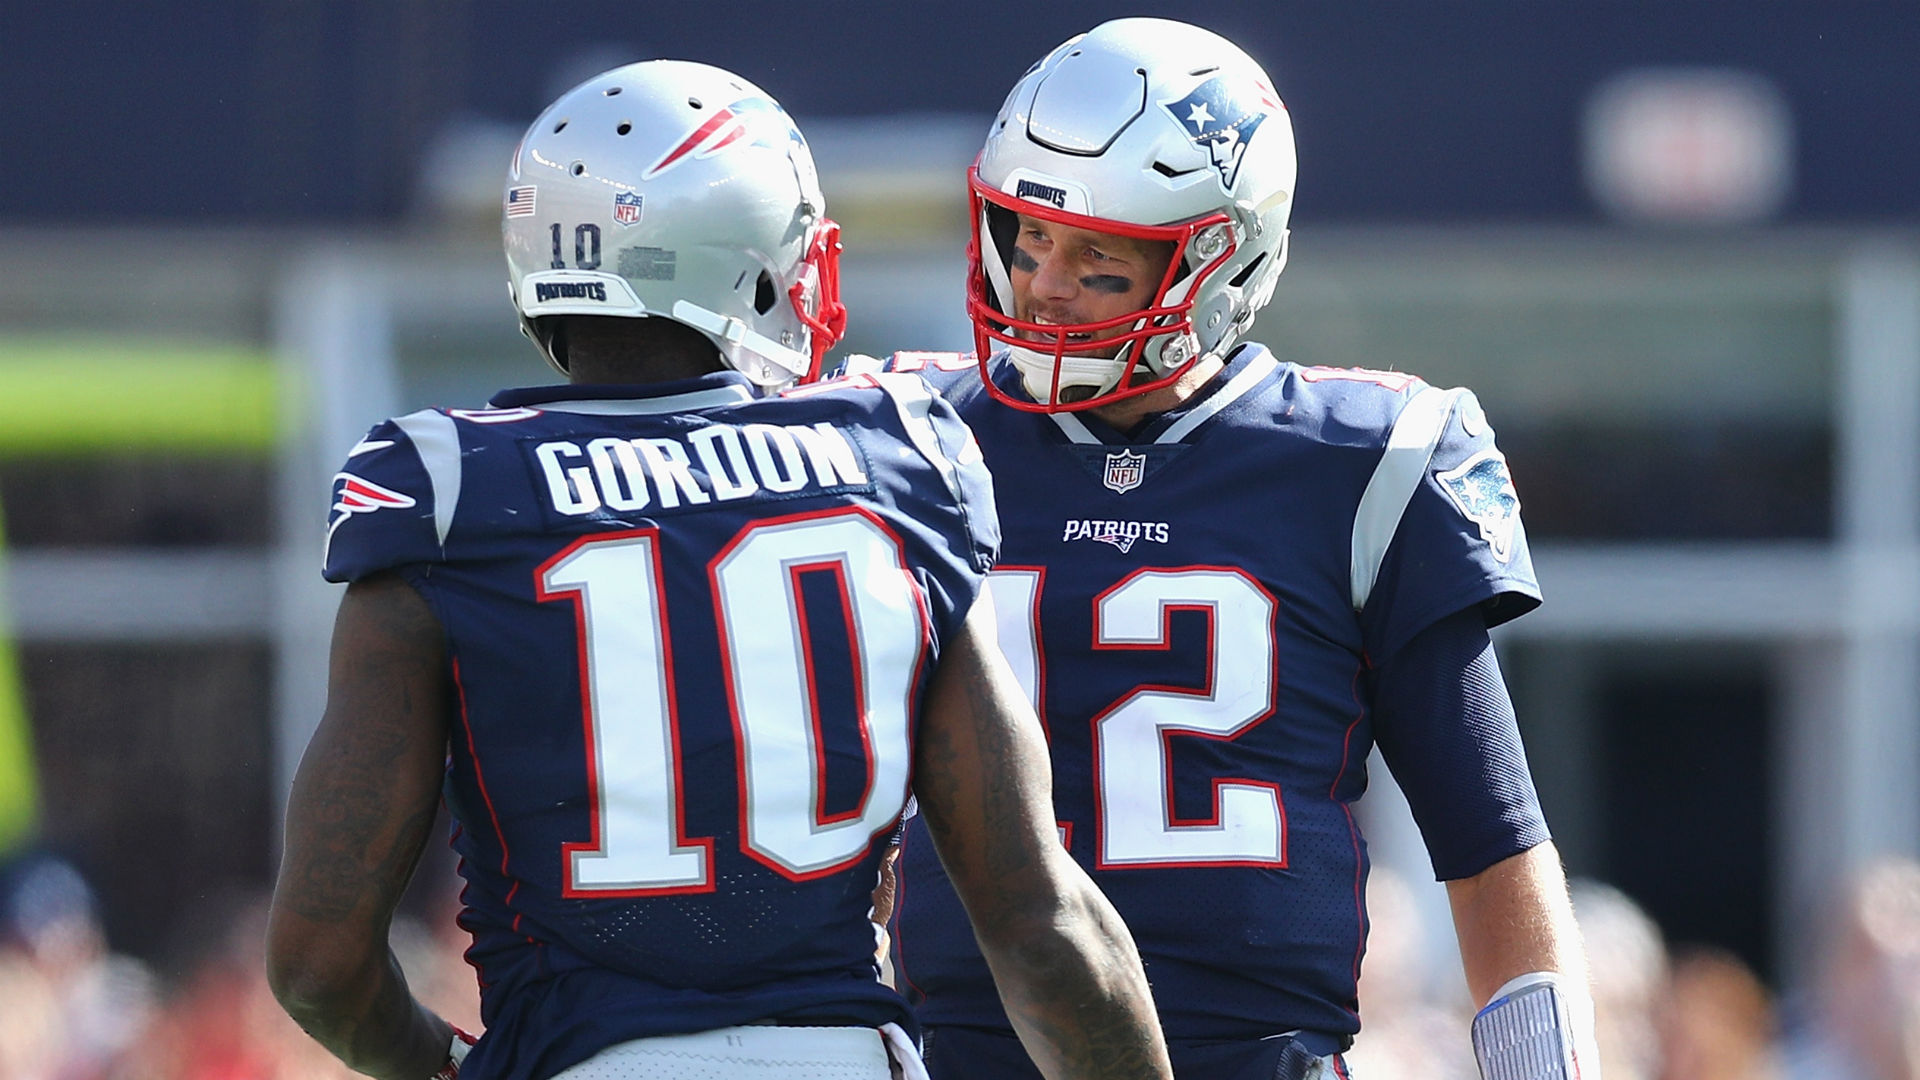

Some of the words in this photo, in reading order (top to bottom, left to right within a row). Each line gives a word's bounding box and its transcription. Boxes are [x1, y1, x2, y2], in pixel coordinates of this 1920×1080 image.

[615, 204, 640, 222] NFL
[549, 223, 602, 270] 10
[535, 282, 607, 302] PATRIOTS
[535, 422, 867, 515] GORDON
[1109, 468, 1137, 485] NFL
[1062, 520, 1170, 544] PATRIOTS
[536, 506, 929, 898] 10
